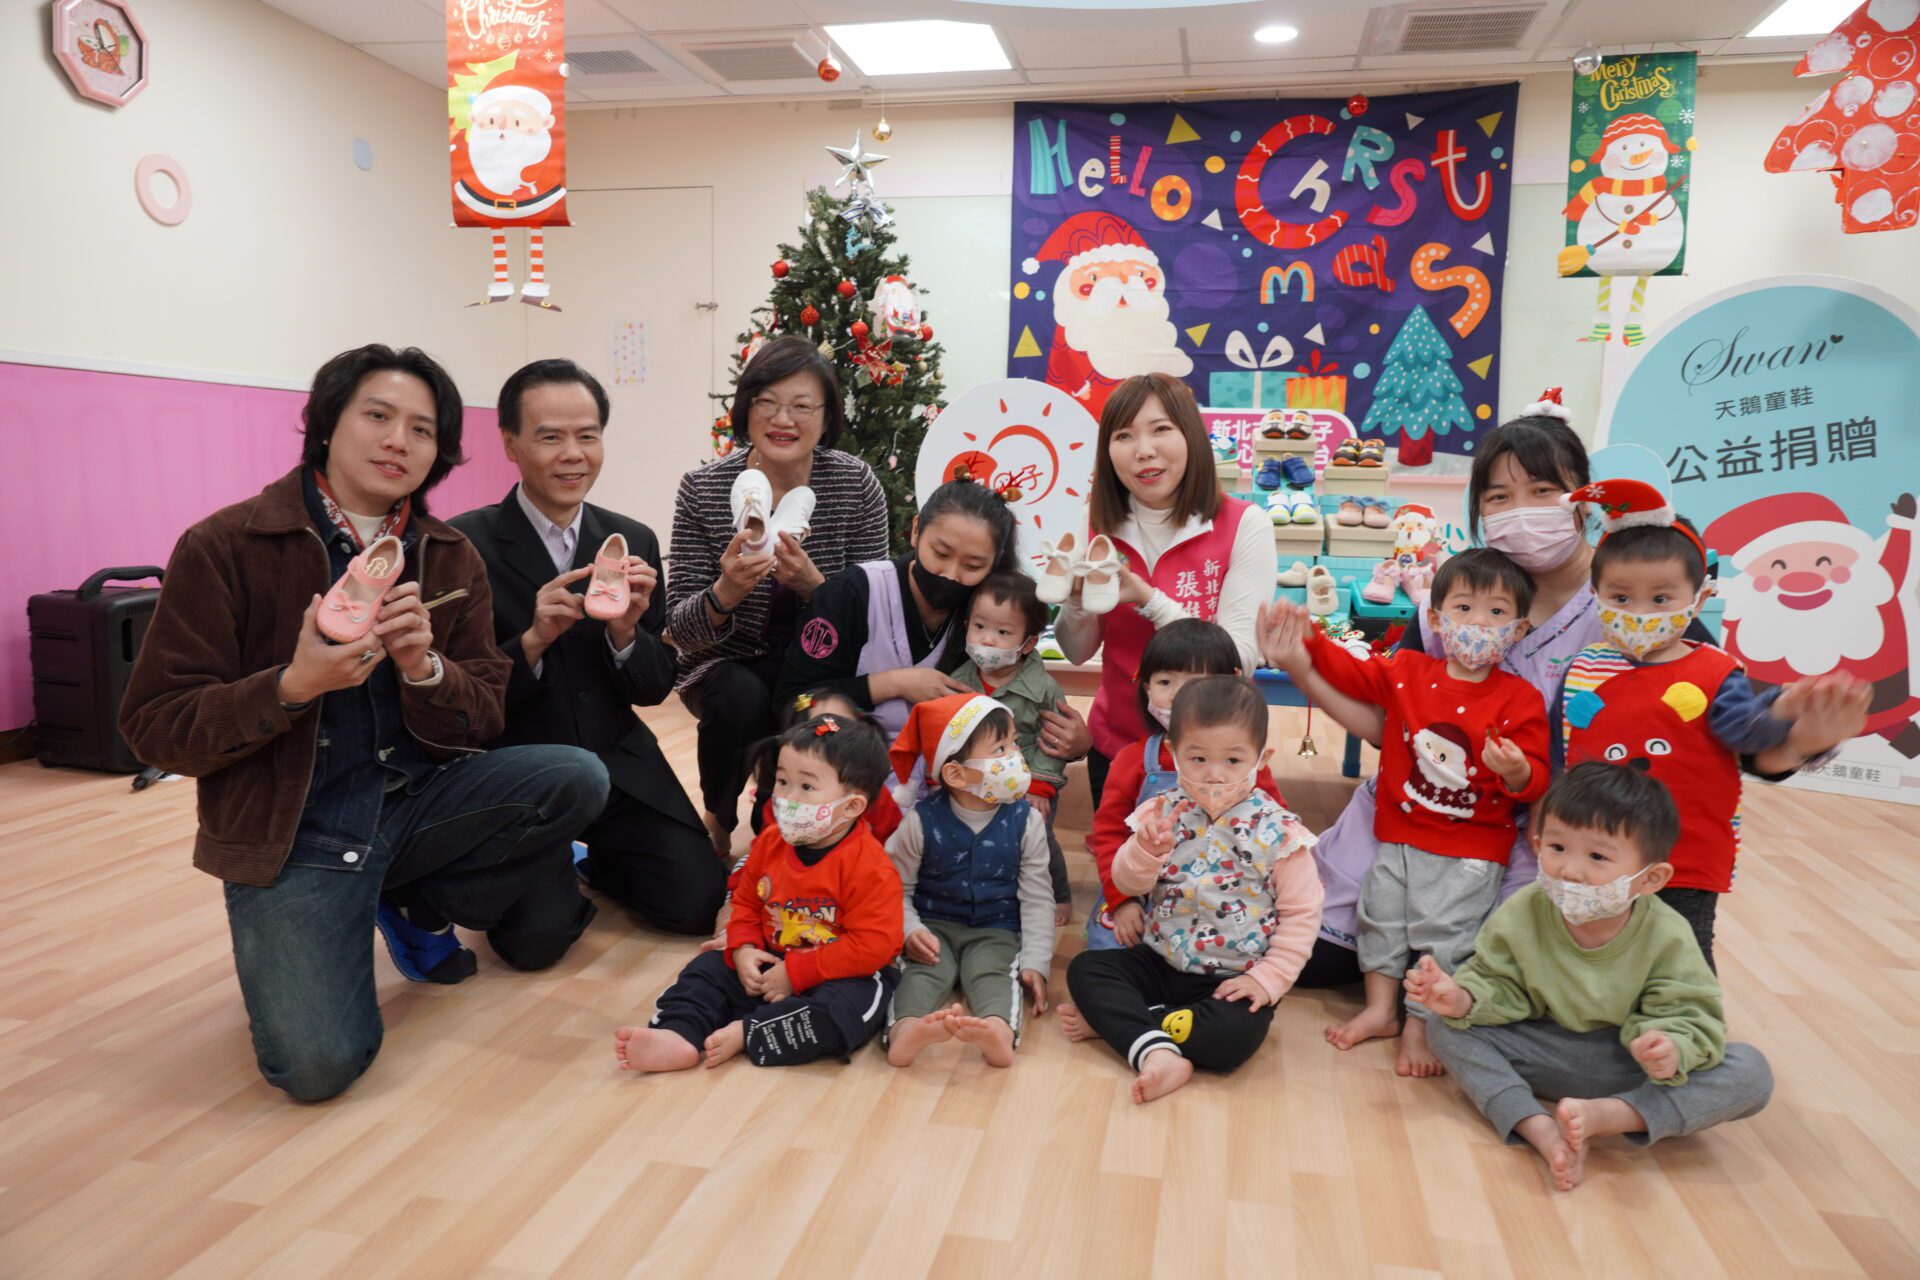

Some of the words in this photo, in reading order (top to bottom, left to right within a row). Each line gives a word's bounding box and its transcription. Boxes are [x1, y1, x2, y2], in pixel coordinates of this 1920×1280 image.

[1681, 326, 1836, 397] Swan
[1715, 386, 1814, 420] 天鵝童鞋
[1666, 416, 1877, 484] 公益捐贈
